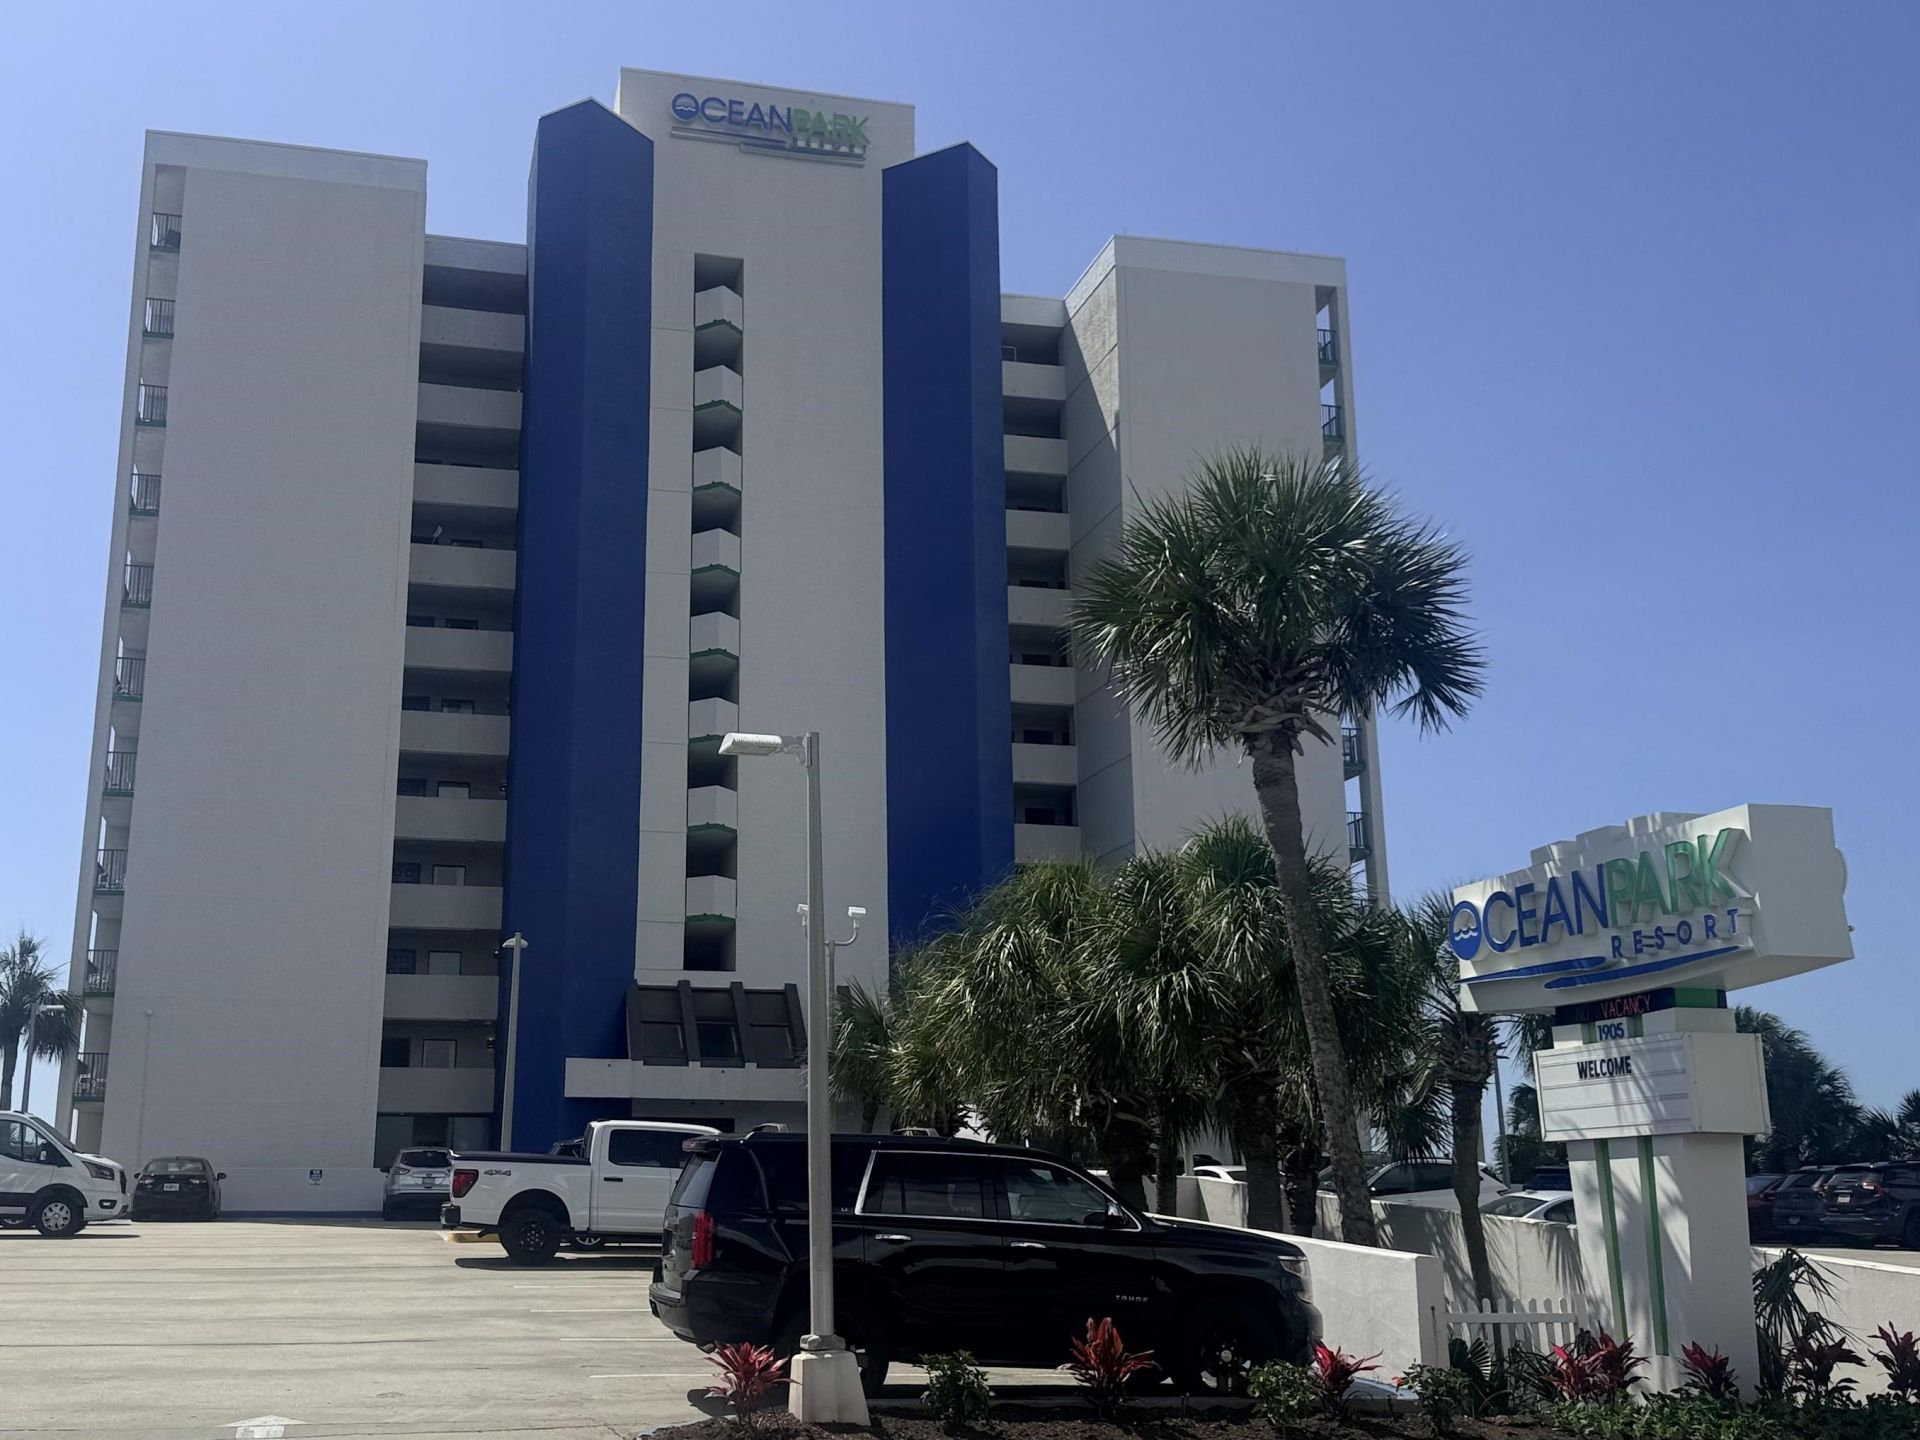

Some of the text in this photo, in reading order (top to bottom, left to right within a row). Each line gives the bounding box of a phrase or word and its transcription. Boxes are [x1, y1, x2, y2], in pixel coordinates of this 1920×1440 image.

[1611, 907, 1740, 959] RESORT
[1601, 994, 1651, 1018] VACANCY
[1597, 1022, 1624, 1040] 1905
[1577, 1055, 1632, 1079] WELCOME
